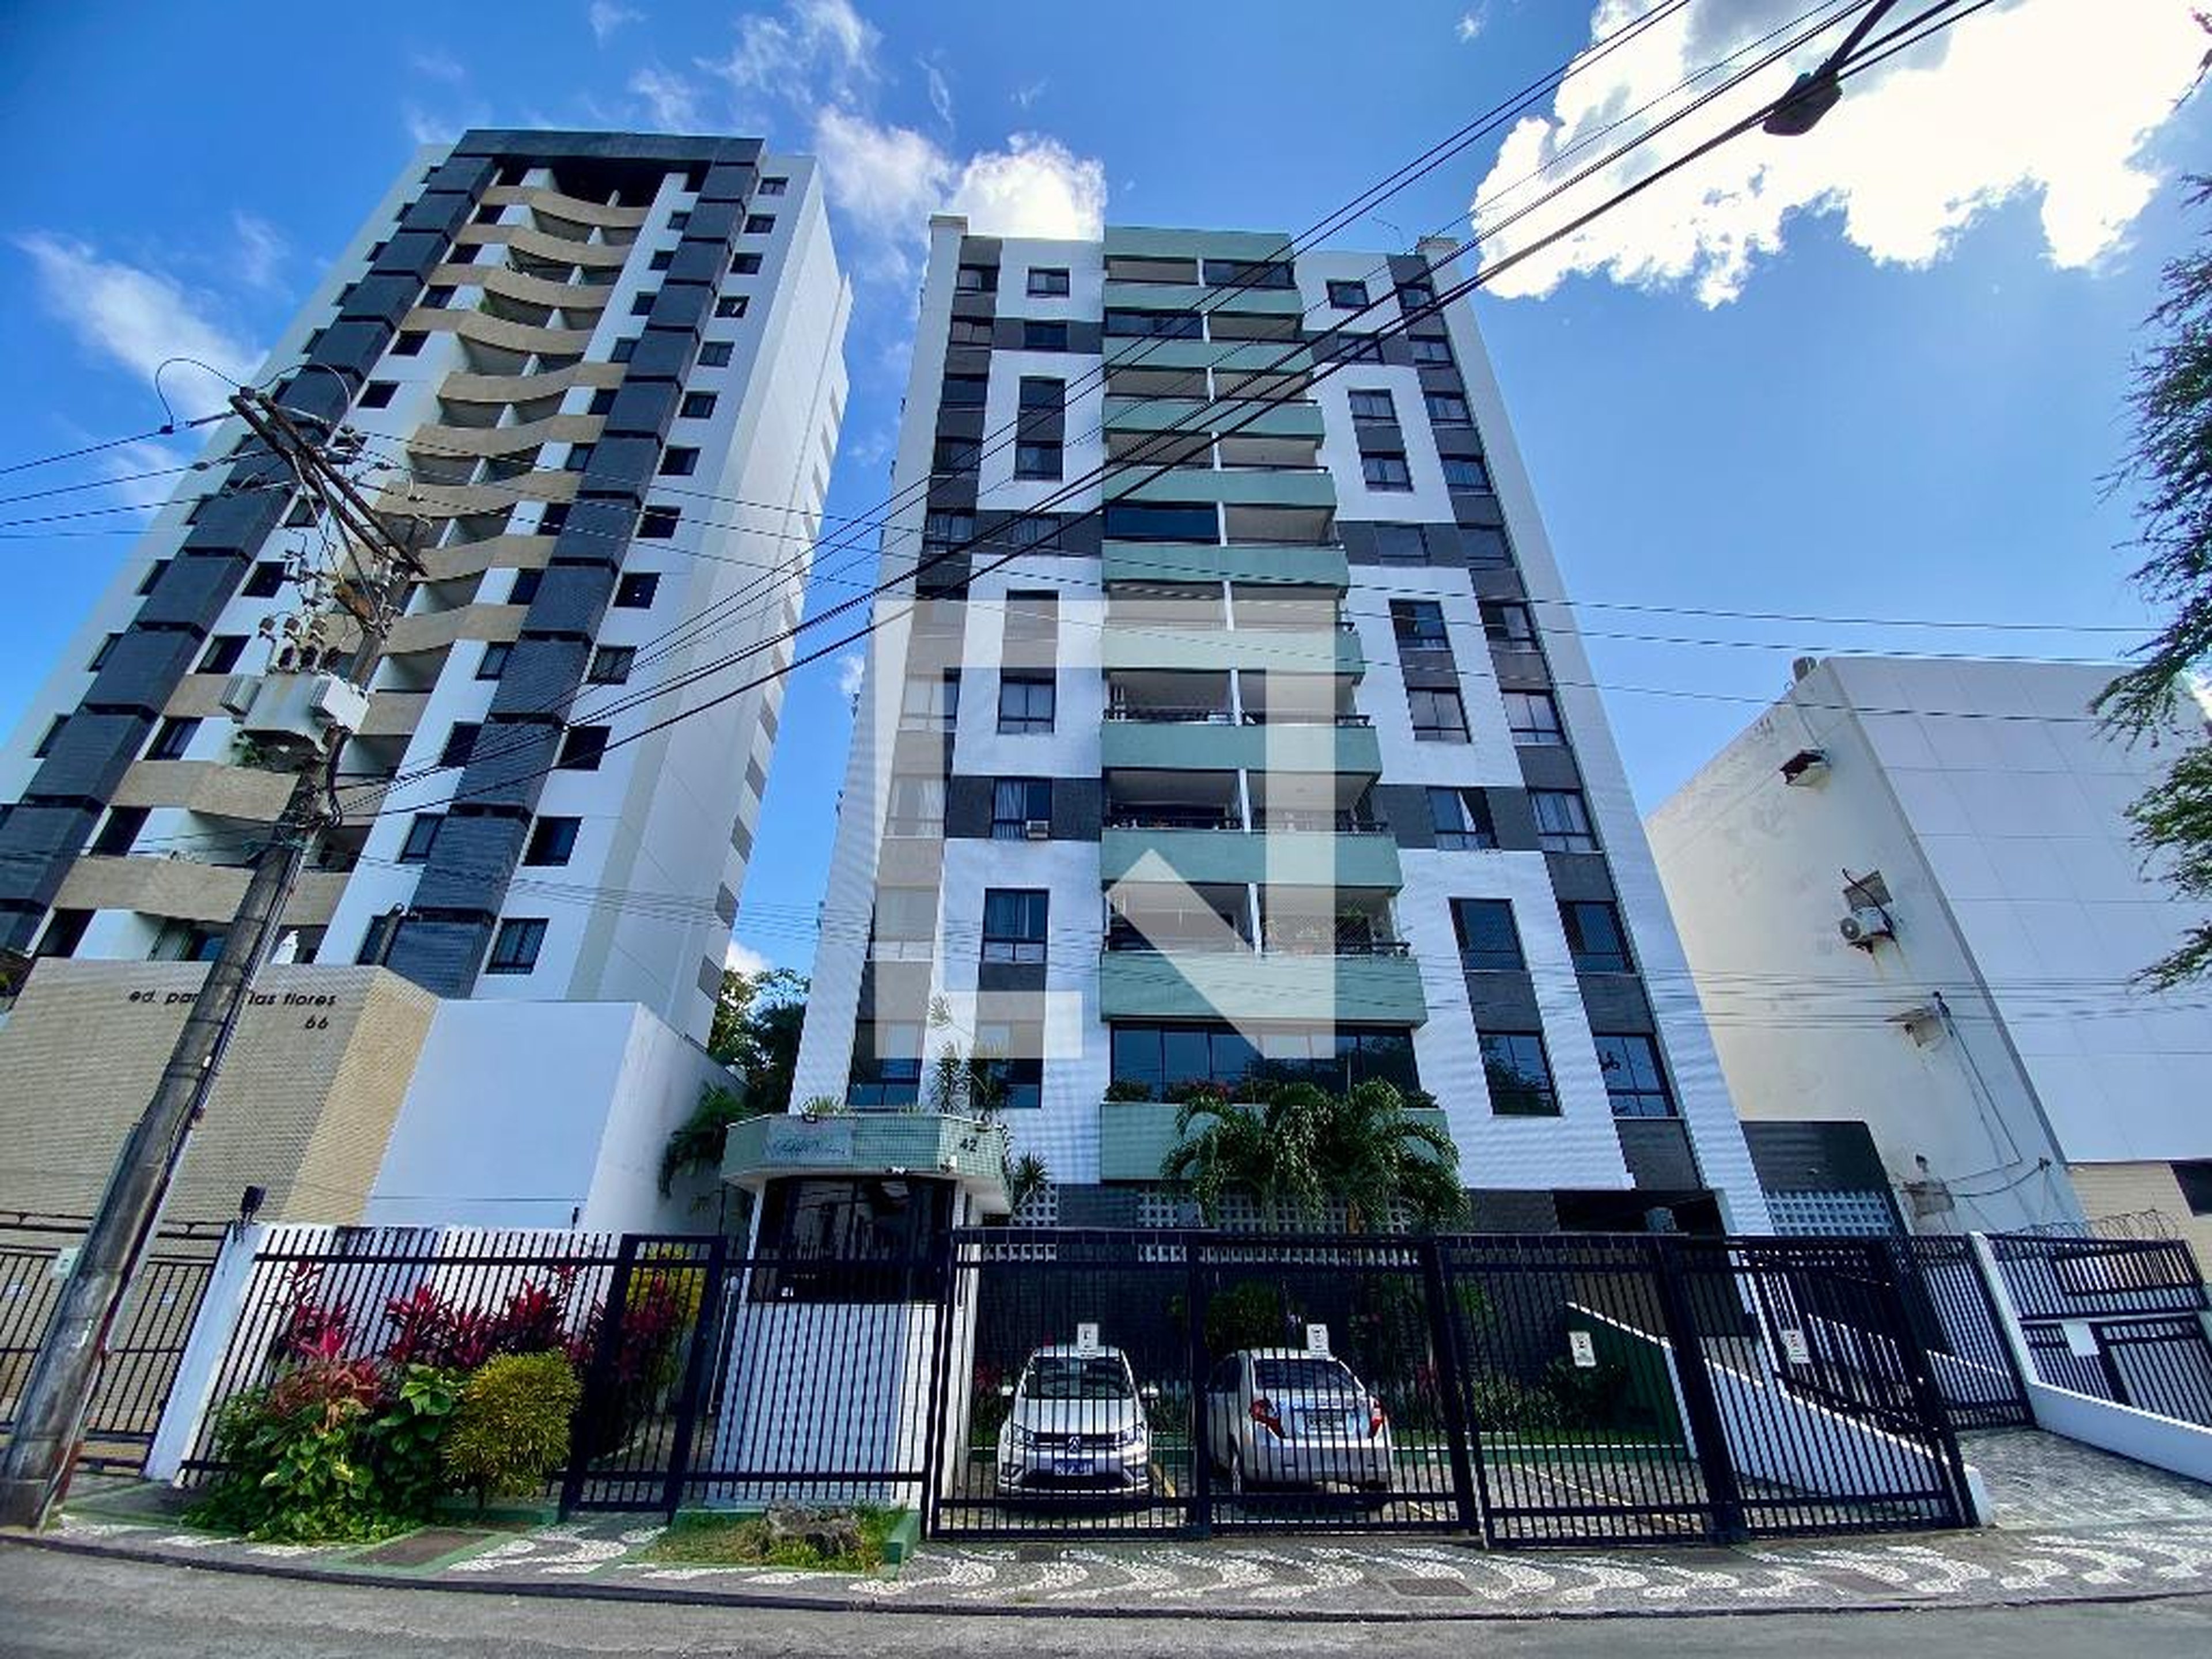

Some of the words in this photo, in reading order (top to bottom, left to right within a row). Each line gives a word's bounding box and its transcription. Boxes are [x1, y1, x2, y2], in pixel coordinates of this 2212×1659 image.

[129, 991, 156, 1003] ed.
[164, 992, 202, 1005] par
[305, 1014, 329, 1029] 66
[959, 1137, 978, 1152] 42
